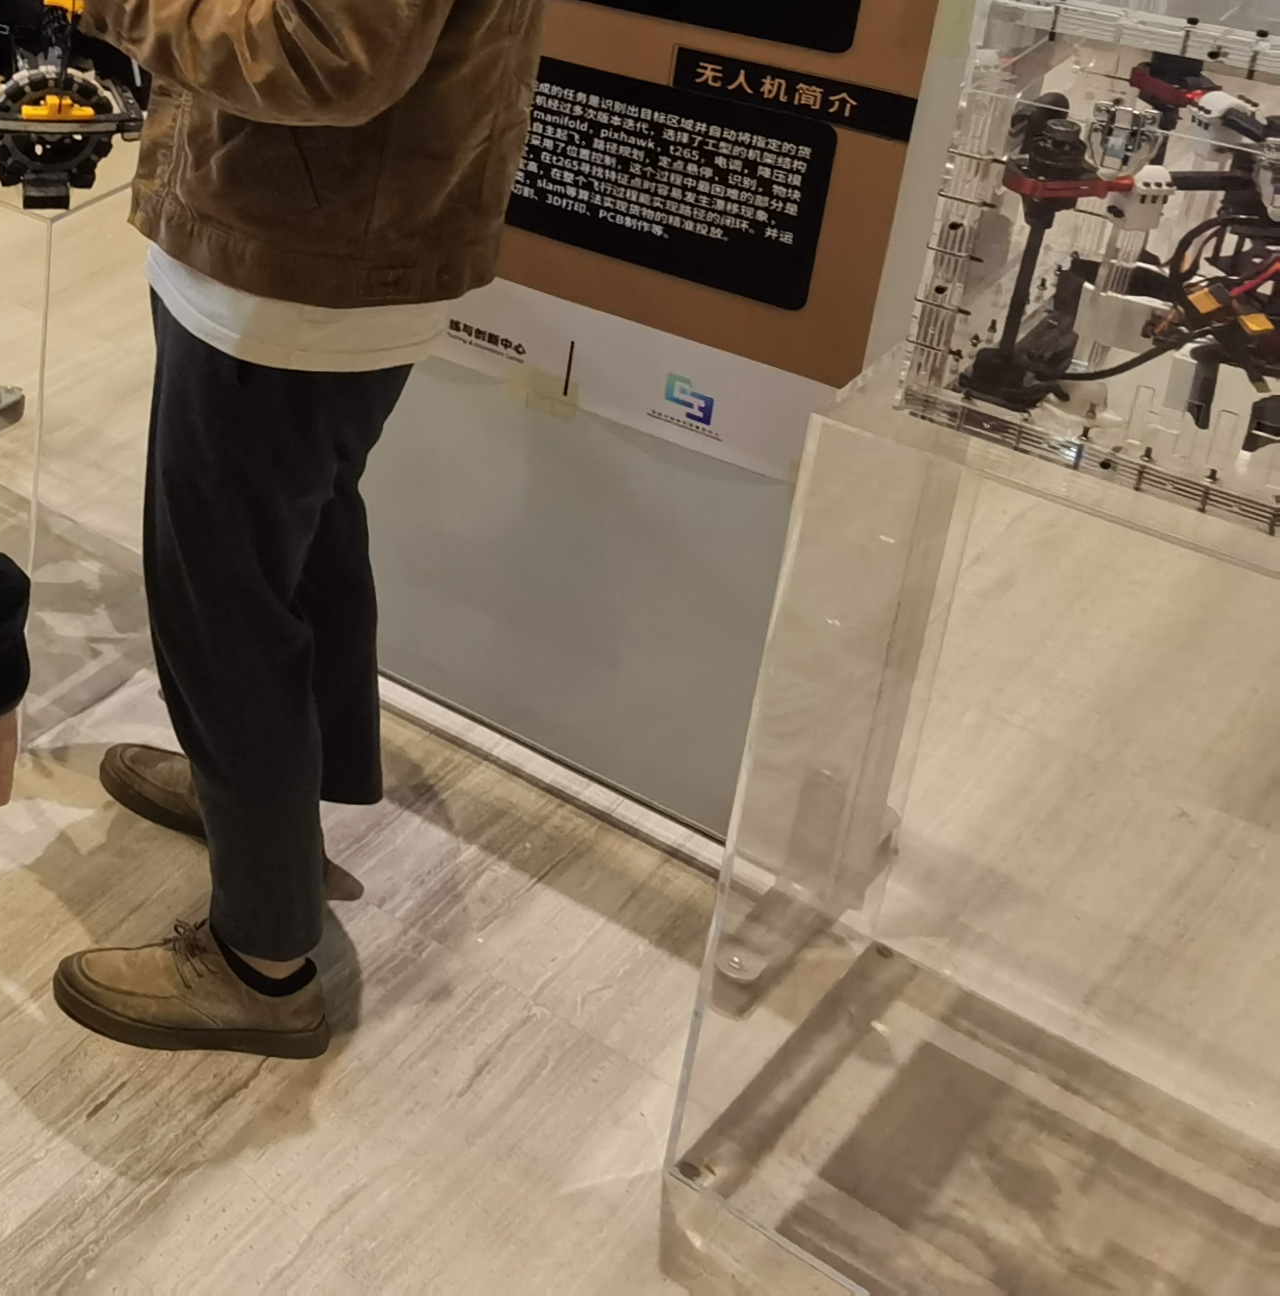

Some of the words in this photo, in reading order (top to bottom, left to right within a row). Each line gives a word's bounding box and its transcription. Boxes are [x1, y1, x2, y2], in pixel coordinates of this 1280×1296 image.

[694, 61, 858, 118] 无人机简介
